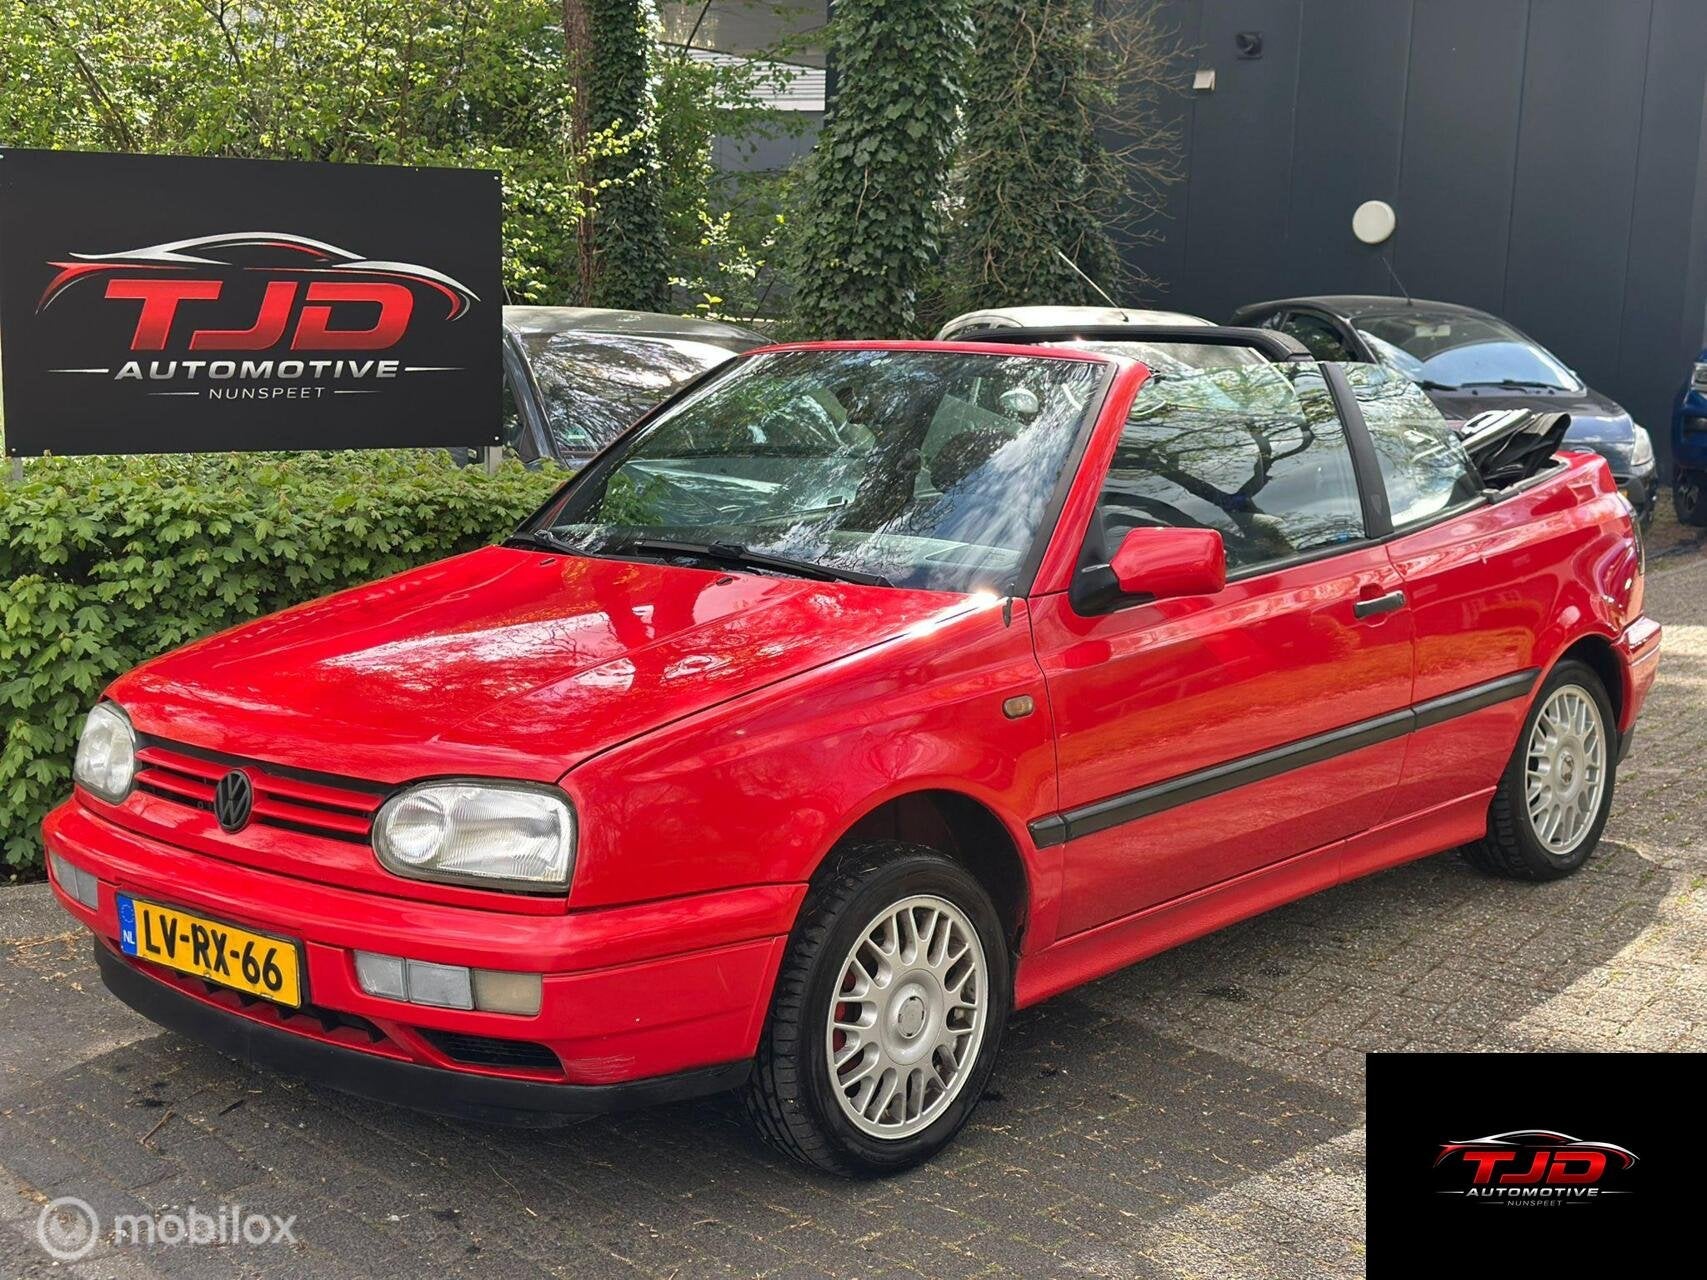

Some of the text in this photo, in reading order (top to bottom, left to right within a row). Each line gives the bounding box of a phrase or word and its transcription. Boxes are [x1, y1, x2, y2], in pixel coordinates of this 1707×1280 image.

[104, 279, 414, 351] TJD
[114, 360, 400, 380] AUTOMOTIVE
[208, 386, 326, 400] NUNSPEET
[123, 929, 136, 945] NL
[143, 910, 283, 991] LV-RX-66
